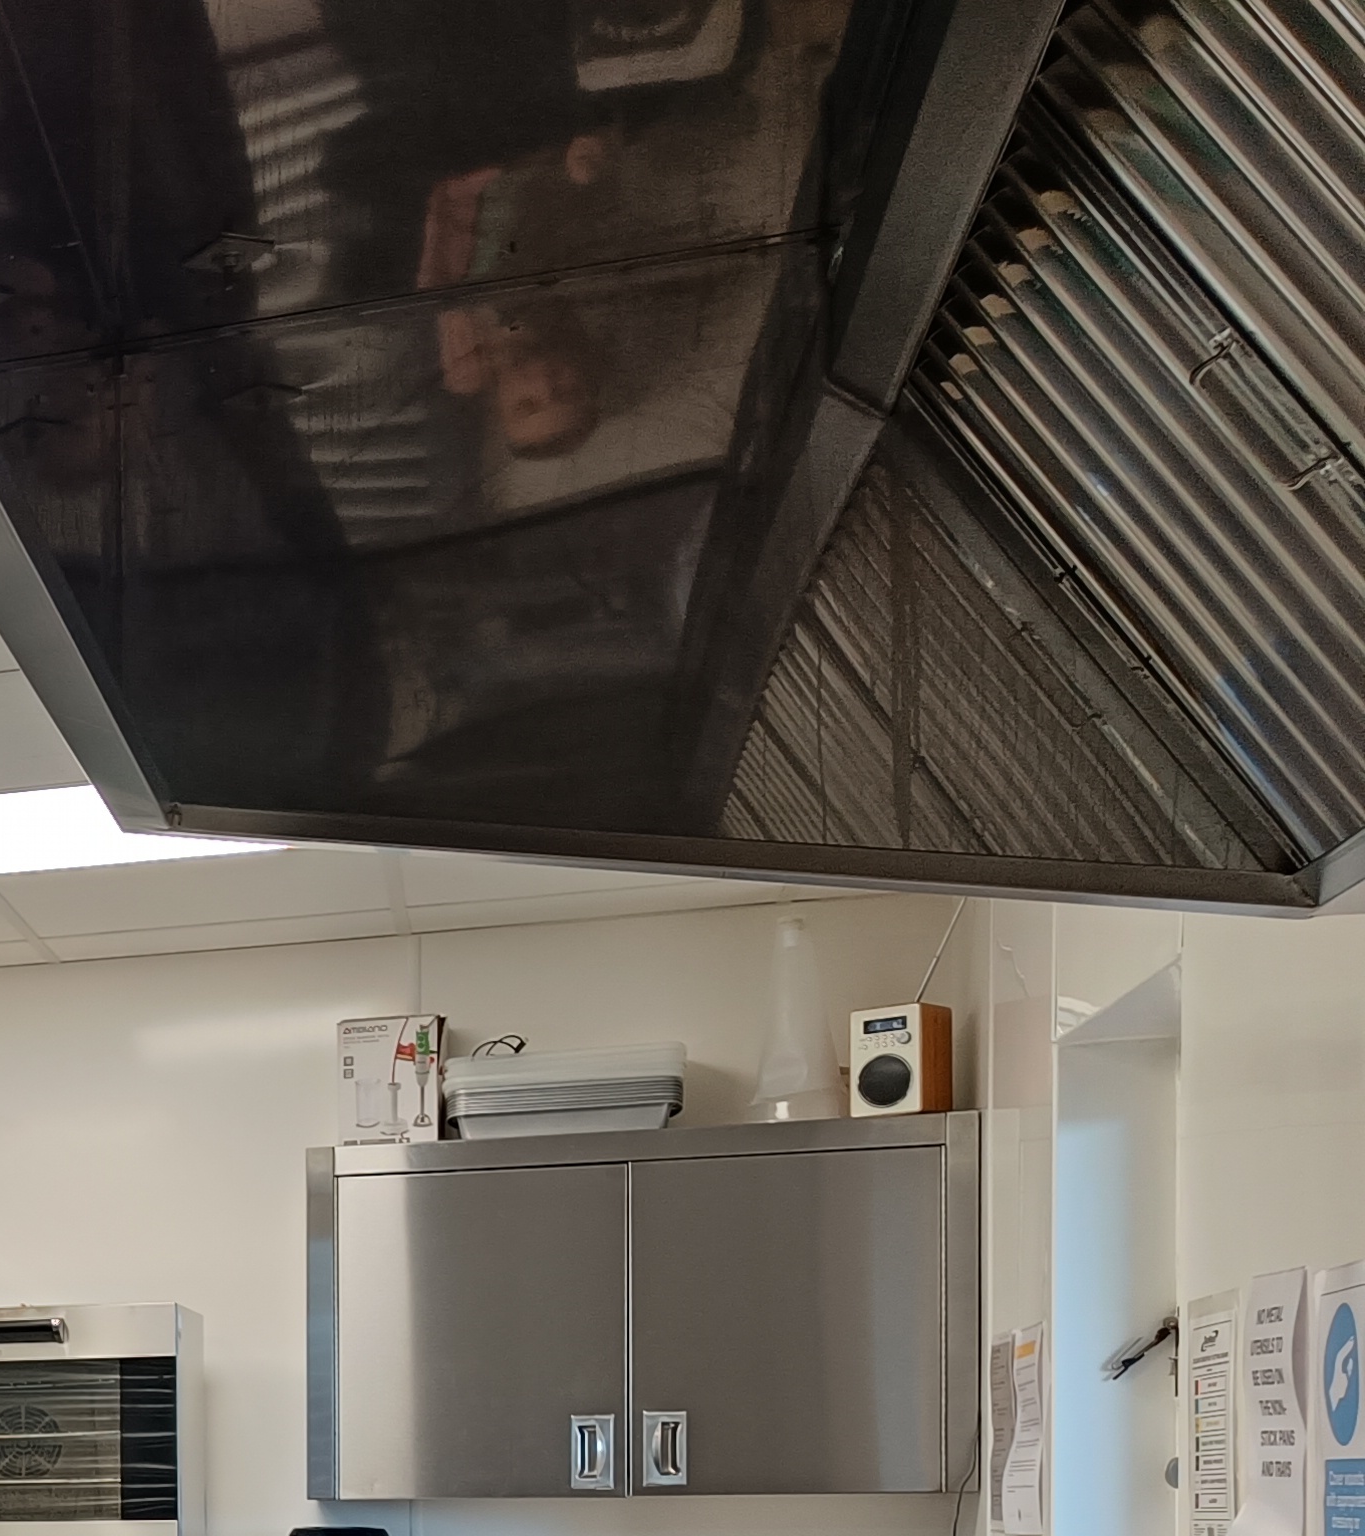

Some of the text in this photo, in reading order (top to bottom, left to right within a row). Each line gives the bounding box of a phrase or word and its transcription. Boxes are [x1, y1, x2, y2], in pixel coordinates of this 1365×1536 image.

[1256, 1306, 1284, 1325] NO METAL
[1251, 1370, 1260, 1386] BE
[1260, 1369, 1275, 1386] USED
[1260, 1430, 1295, 1446] STICK PANS
[1261, 1461, 1273, 1477] AND
